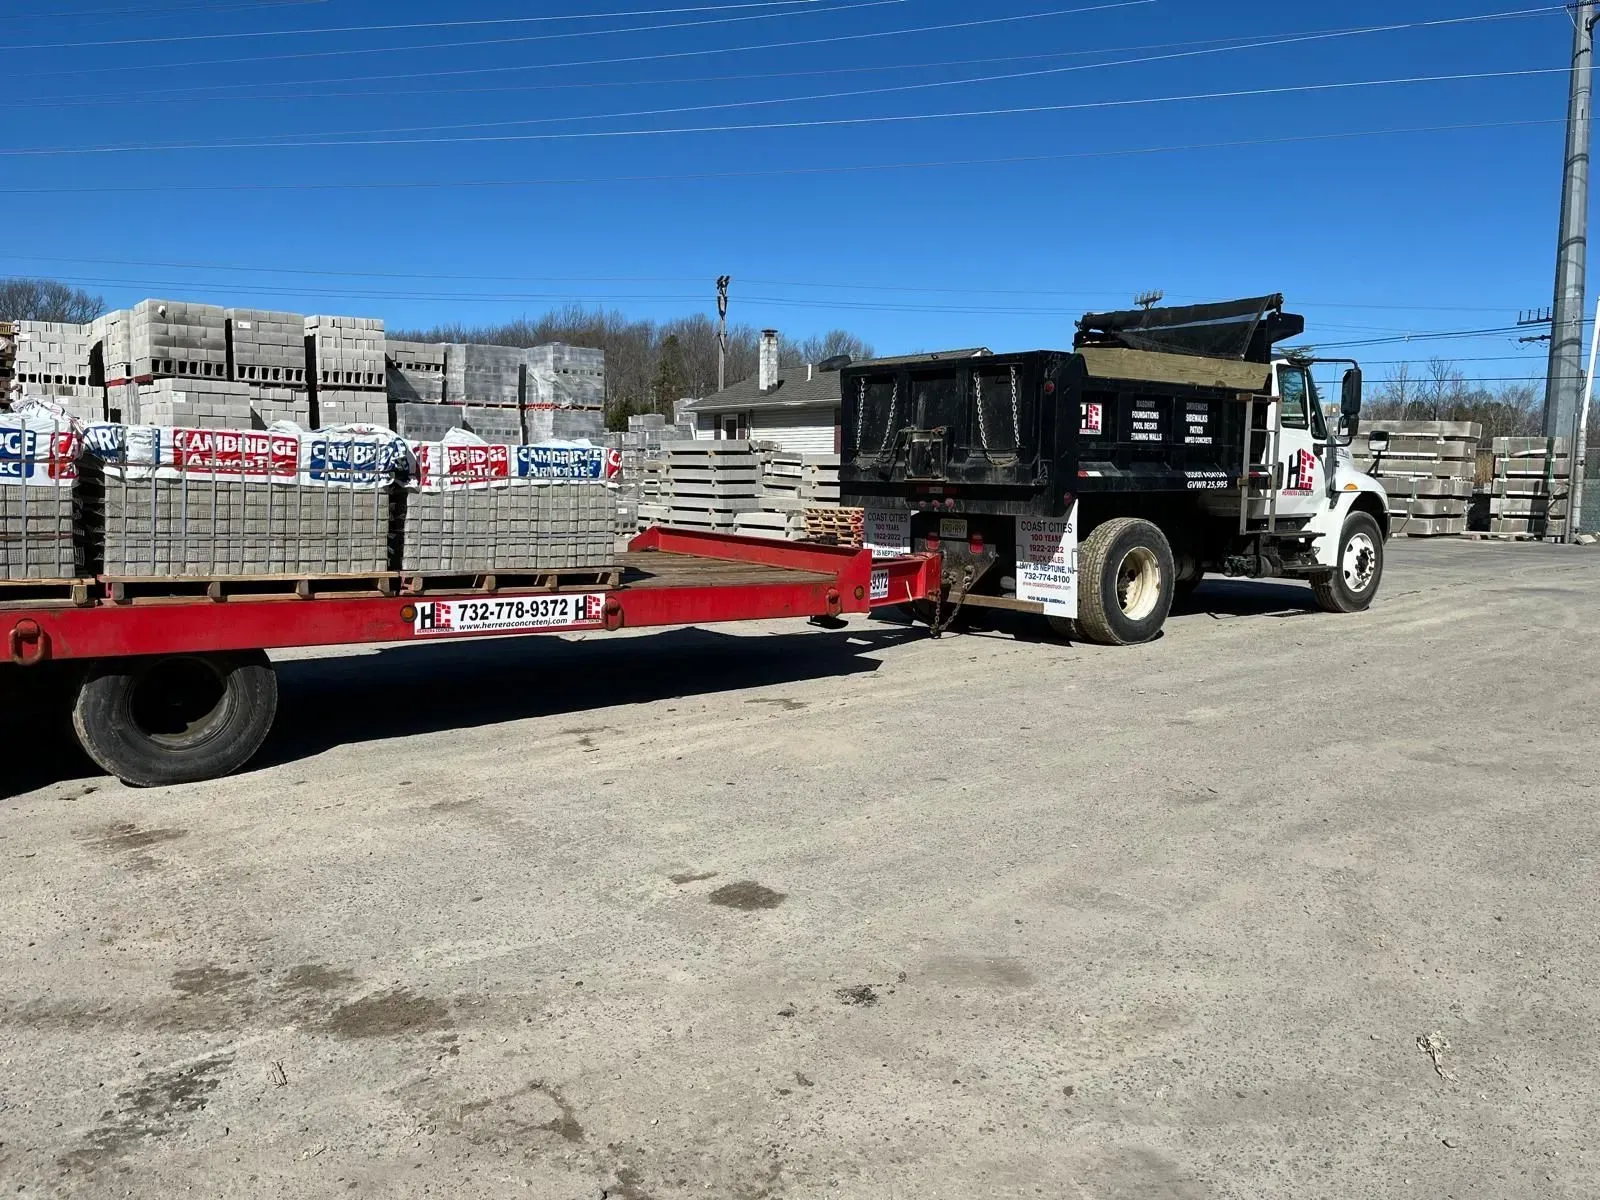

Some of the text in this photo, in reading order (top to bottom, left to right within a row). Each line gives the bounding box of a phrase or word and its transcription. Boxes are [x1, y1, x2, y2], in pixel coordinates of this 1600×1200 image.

[1131, 410, 1160, 420] FOUNDATIONS
[1186, 413, 1208, 423] SIDEWALKS
[1132, 422, 1158, 431] POOL DECKS
[1189, 425, 1204, 435] PATIOS
[1149, 433, 1162, 441] WALLS
[1195, 436, 1213, 444] CONCRETE
[174, 434, 297, 456] CAMBRIDGE
[1187, 480, 1228, 490] GVWR 25,995
[868, 512, 908, 522] COAST CITIES
[1021, 520, 1073, 534] COAST CITIES
[1045, 534, 1062, 542] YEARS
[1029, 544, 1064, 553] 1922-2022
[1030, 554, 1065, 564] TRUCK SALES
[1033, 563, 1040, 571] 35
[1024, 572, 1070, 584] 732-774-8100
[458, 598, 568, 622] 732-778-9372
[459, 617, 568, 630] www.herreraconcretenj.com
